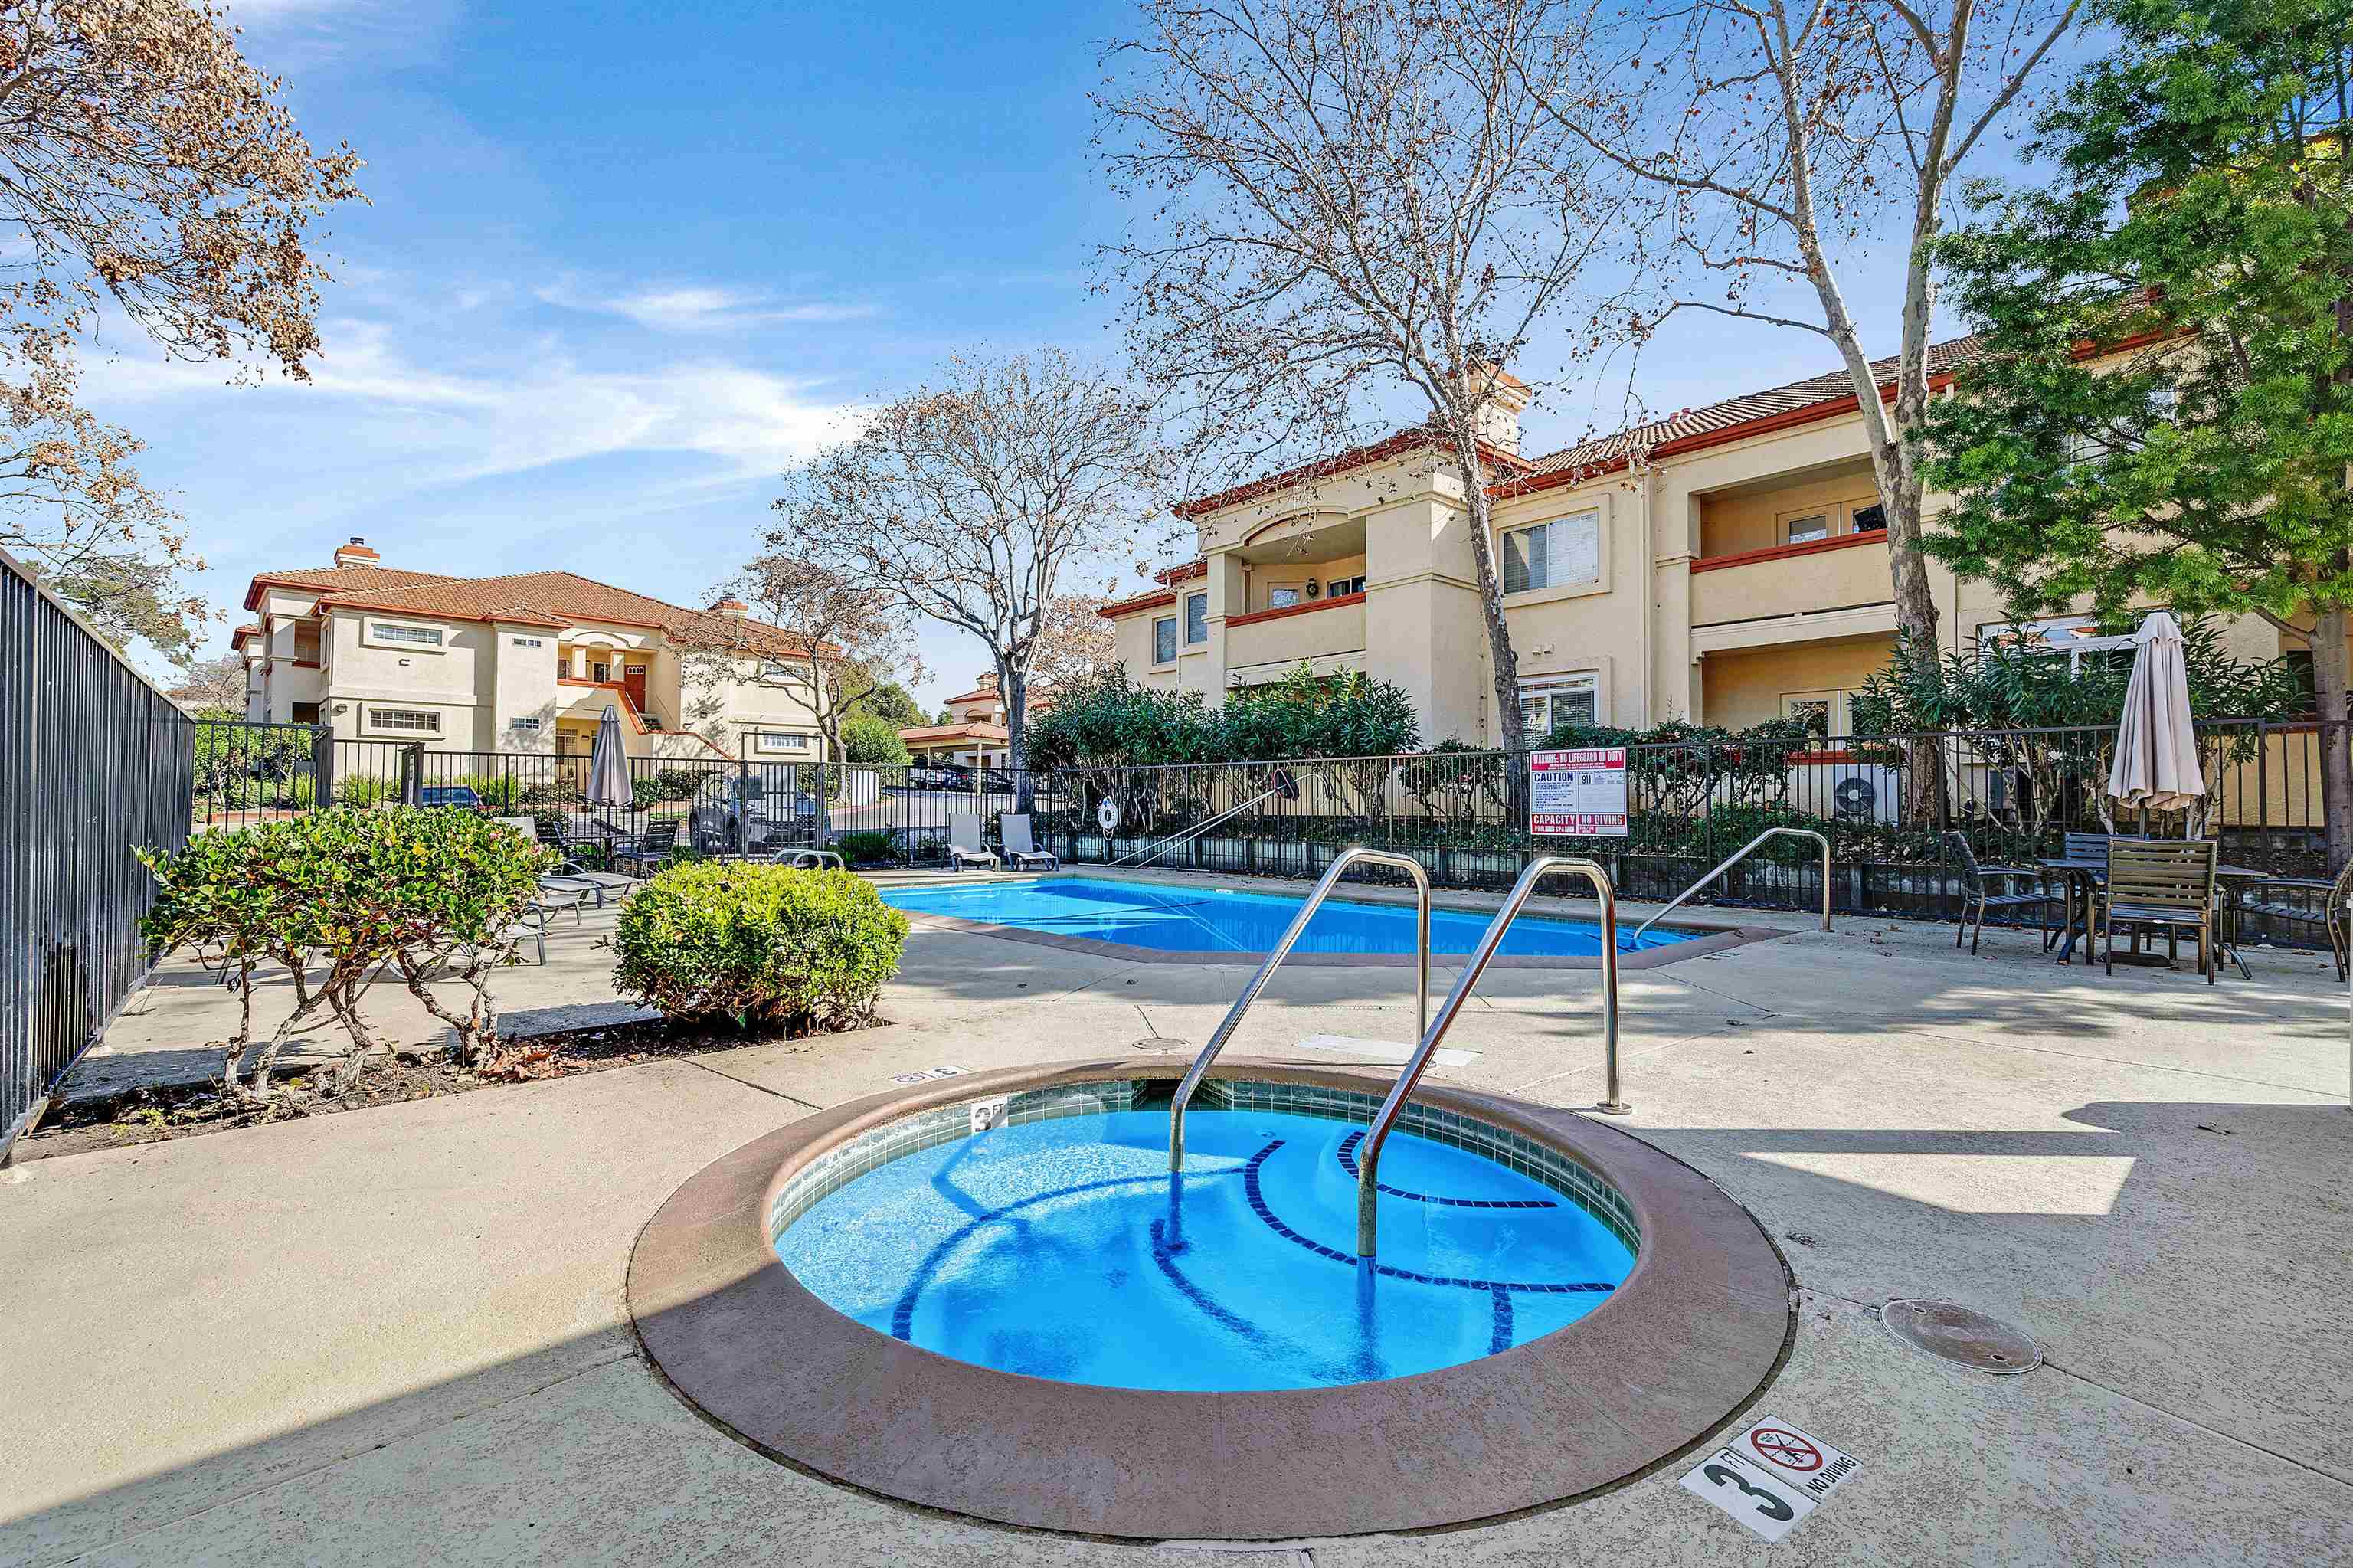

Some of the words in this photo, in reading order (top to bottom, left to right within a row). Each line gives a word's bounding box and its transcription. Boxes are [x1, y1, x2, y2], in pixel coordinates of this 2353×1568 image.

[1533, 753, 1559, 764] WARNING:
[1559, 752, 1567, 764] NO
[1568, 751, 1598, 763] LIFEGUARD
[1599, 751, 1605, 762] ON
[1607, 751, 1623, 761] DUTY
[1534, 772, 1574, 782] CAUTION
[1582, 774, 1592, 784] 911
[1533, 814, 1575, 824] CAPACITY
[1581, 814, 1592, 824] NO
[1595, 814, 1623, 825] DIVING
[974, 1107, 992, 1132] 3
[1720, 1452, 1745, 1469] FT
[1805, 1478, 1829, 1494] NO
[1818, 1456, 1857, 1484] DIVING
[1703, 1464, 1794, 1521] 3
